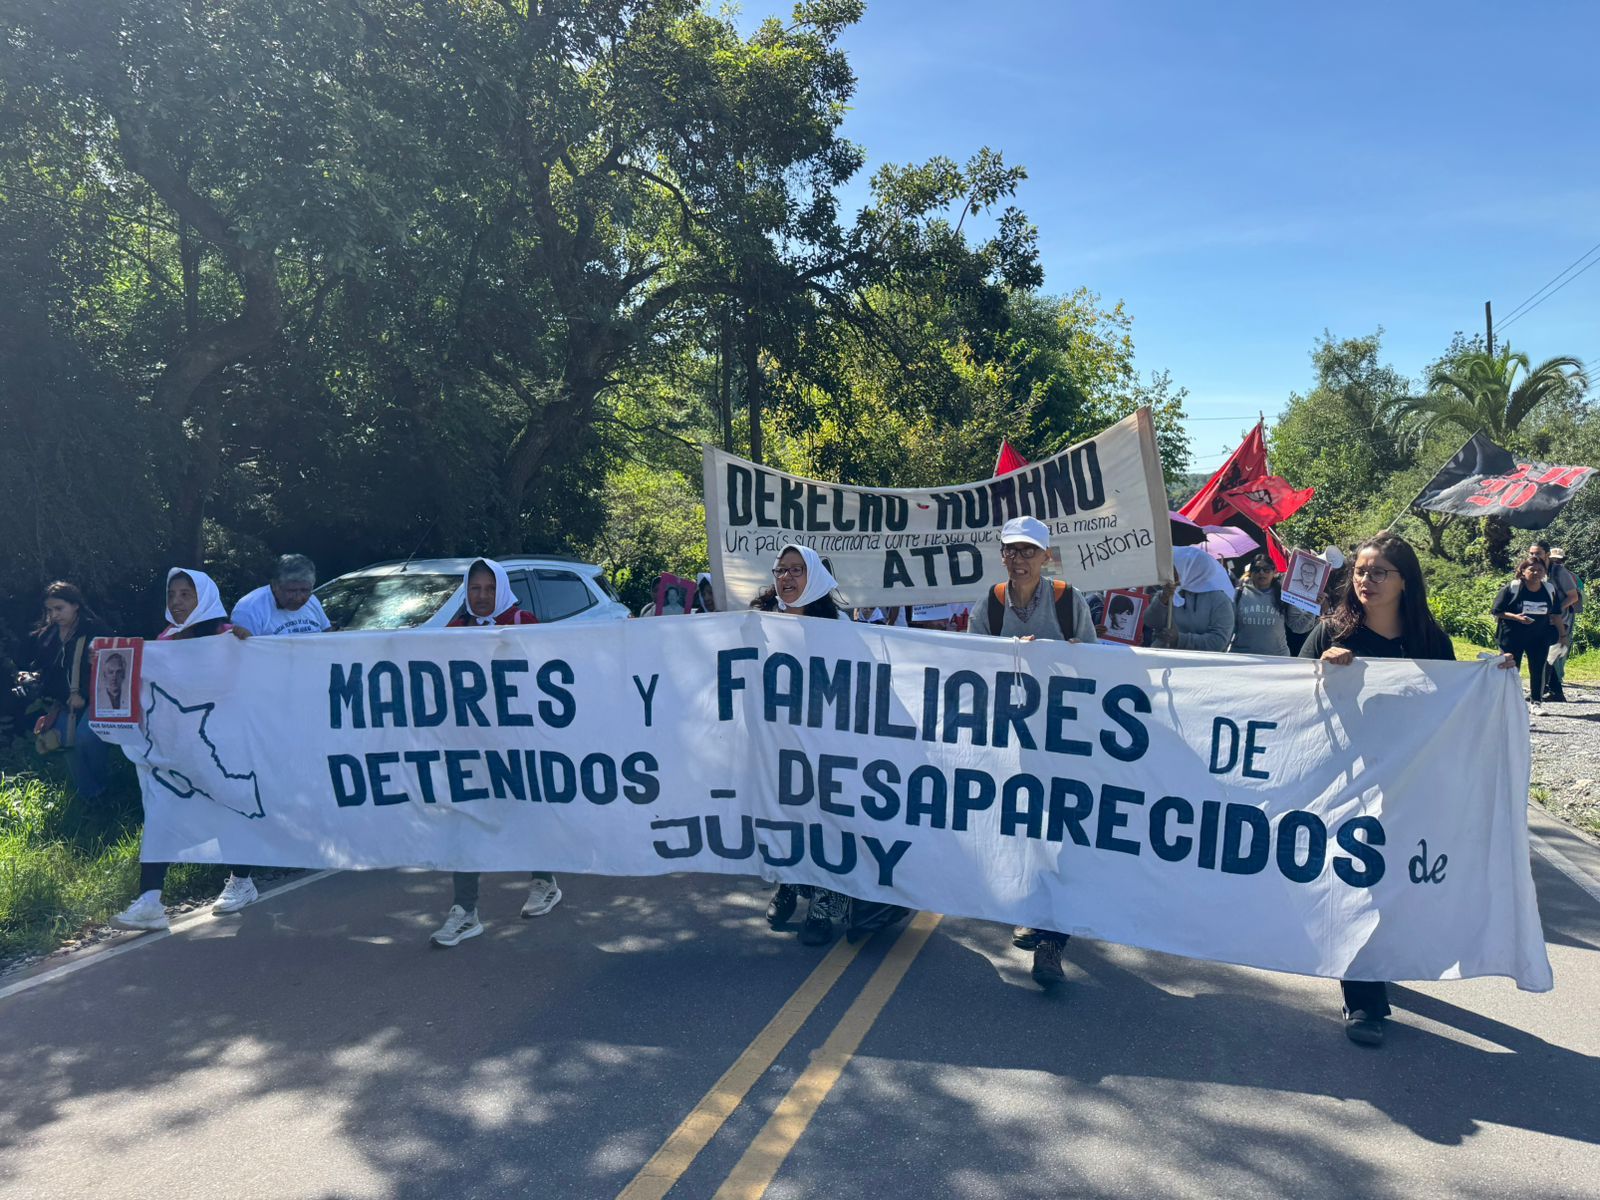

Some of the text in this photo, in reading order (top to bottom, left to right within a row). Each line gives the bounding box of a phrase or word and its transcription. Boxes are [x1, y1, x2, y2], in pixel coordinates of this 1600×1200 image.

[724, 527, 750, 553] Un
[753, 529, 789, 556] país
[795, 533, 816, 551] sin
[820, 532, 881, 552] memoria
[1056, 521, 1070, 534] la
[1073, 514, 1118, 533] misma
[1077, 528, 1154, 571] Historia
[883, 542, 983, 589] ATD
[328, 647, 1278, 780] MADRES Y FAMILIARES DE
[327, 749, 661, 808] DETENIDOS
[778, 749, 1387, 889] DESAPARECIDOS
[1408, 838, 1449, 885] de
[650, 814, 913, 888] JUJUY
